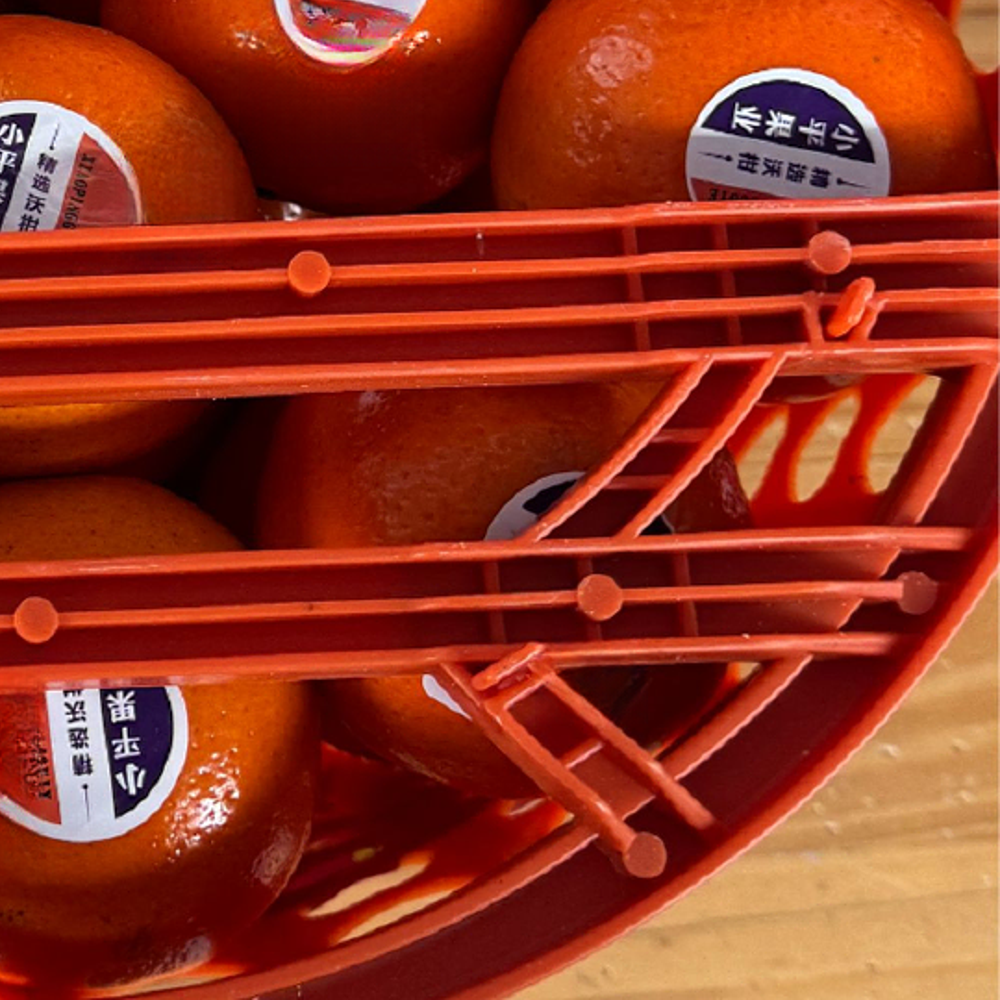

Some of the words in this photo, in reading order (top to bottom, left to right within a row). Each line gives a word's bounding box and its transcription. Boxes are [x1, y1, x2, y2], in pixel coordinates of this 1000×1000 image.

[731, 102, 861, 152] 小平果业
[736, 152, 832, 190] 精选沃柑
